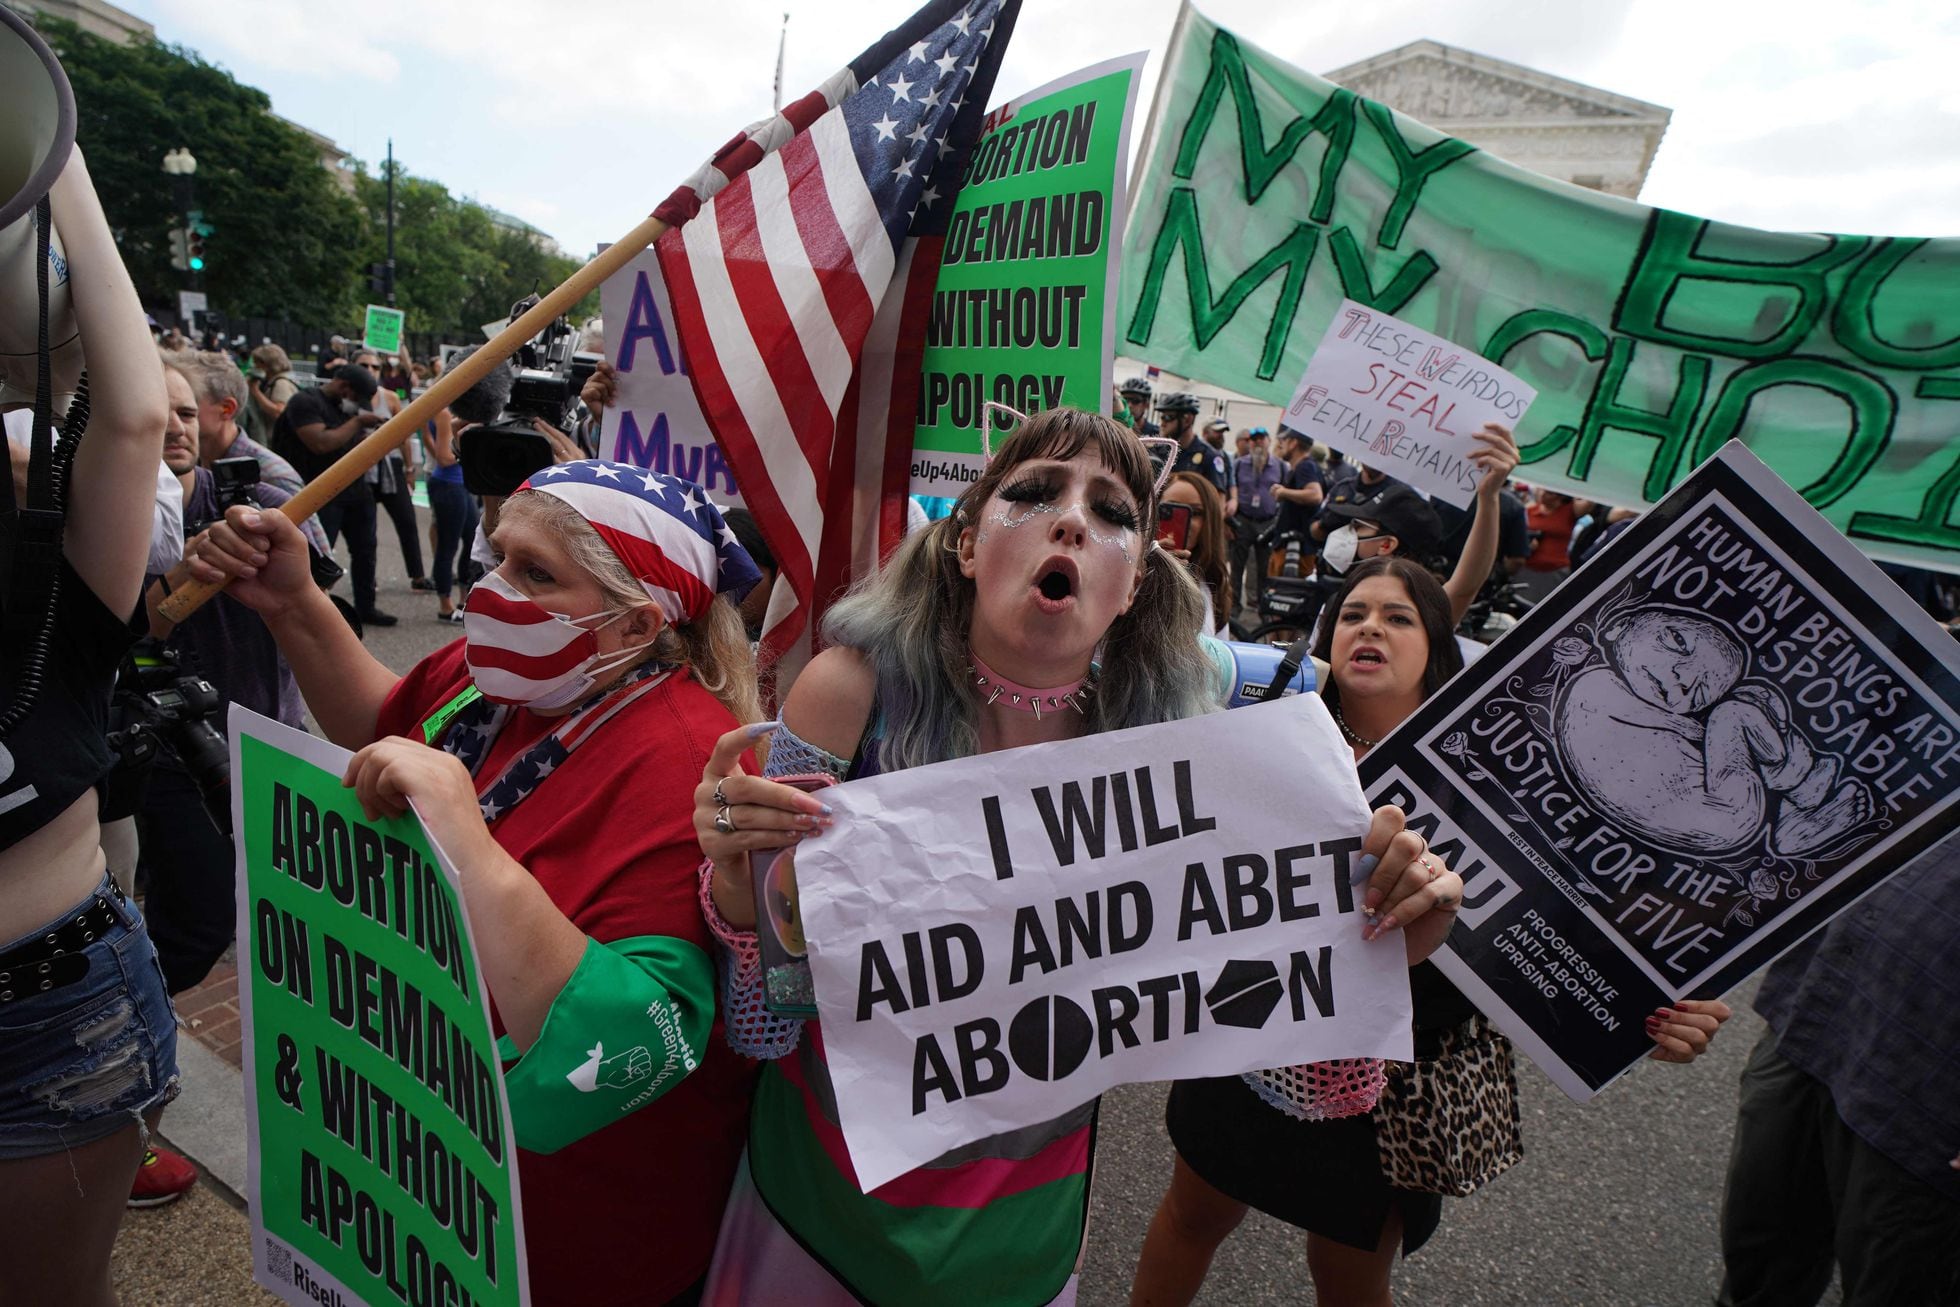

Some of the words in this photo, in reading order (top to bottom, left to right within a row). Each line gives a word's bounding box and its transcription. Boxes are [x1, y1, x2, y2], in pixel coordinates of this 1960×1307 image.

[959, 101, 1097, 191] BORTION
[1172, 28, 1478, 250] MY
[943, 190, 1104, 267] DEMAND
[928, 285, 1087, 350] WITHOUT
[1126, 188, 1439, 382] MY
[1338, 308, 1422, 367] THESE
[1415, 345, 1529, 420] WEIRDOS
[1350, 362, 1456, 438] STEAL
[911, 459, 983, 484] eUp4Abo
[1290, 384, 1370, 446] FETAL
[1369, 419, 1483, 493] REMAINS
[1636, 544, 1737, 610] NOT
[1736, 604, 1934, 813] DISPOSABLE
[1688, 516, 1805, 621] HUMAN
[1790, 610, 1908, 717] BEINGS
[1893, 712, 1960, 780] ARE
[981, 795, 1014, 881] I
[1031, 759, 1217, 867] WILL
[1471, 710, 1590, 834] JUSTICE
[1573, 825, 1657, 895] FOR
[1663, 861, 1733, 909] THE
[272, 781, 470, 1003] ABORTION
[1508, 831, 1528, 850] REST
[1525, 848, 1537, 858] IN
[1533, 856, 1559, 881] PEACE
[1556, 878, 1589, 909] HARRIET
[855, 921, 986, 1022] AID
[1008, 880, 1154, 985] AND
[1177, 836, 1363, 942] ABET
[1493, 933, 1559, 999] UPRISING
[1506, 923, 1621, 1033] ANTI-ABORTION
[1522, 908, 1620, 1003] PROGRESSIVE
[1614, 892, 1725, 975] FIVE
[257, 897, 314, 1007] ON
[324, 934, 502, 1168] DEMAND
[275, 1032, 305, 1115] &
[315, 1044, 500, 1289] WITHOUT
[302, 1148, 480, 1307] APOLOG
